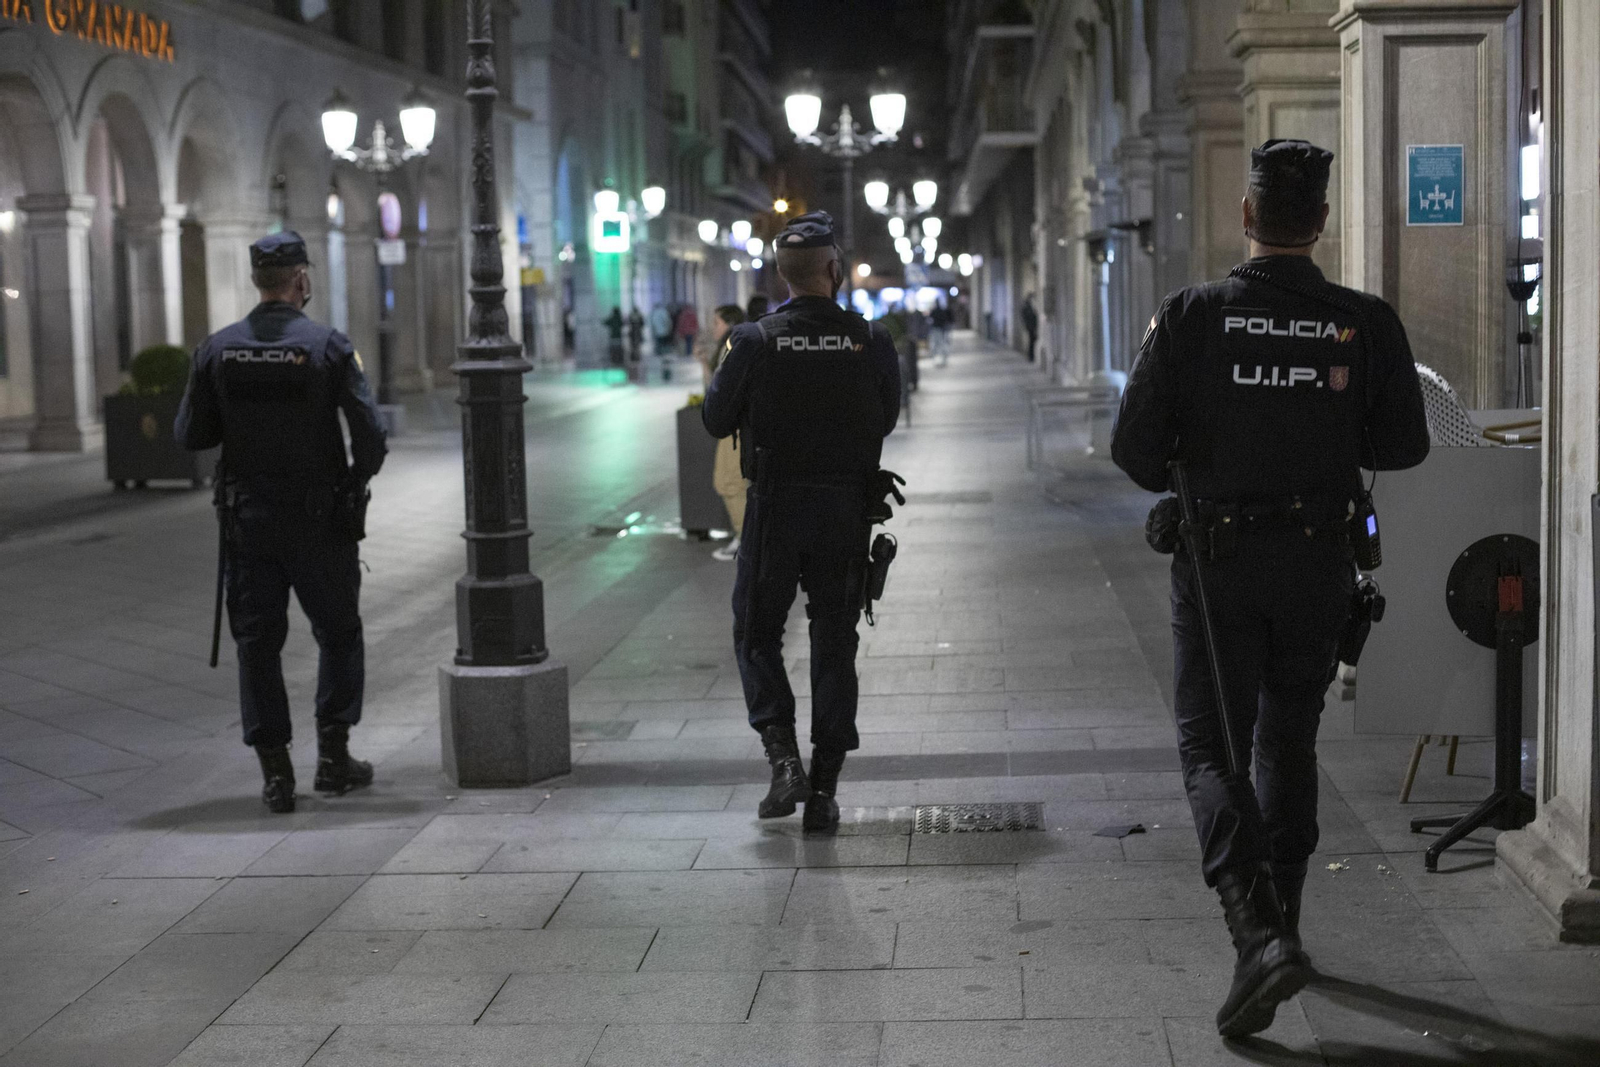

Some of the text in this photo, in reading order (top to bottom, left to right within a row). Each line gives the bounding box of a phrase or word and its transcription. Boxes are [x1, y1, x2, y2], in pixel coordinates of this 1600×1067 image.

[45, 0, 175, 63] GRANADA
[1224, 316, 1339, 338] POLICIA
[776, 335, 853, 351] POLICIA
[222, 349, 296, 364] POLICIA
[1233, 364, 1323, 387] U.I.P.
